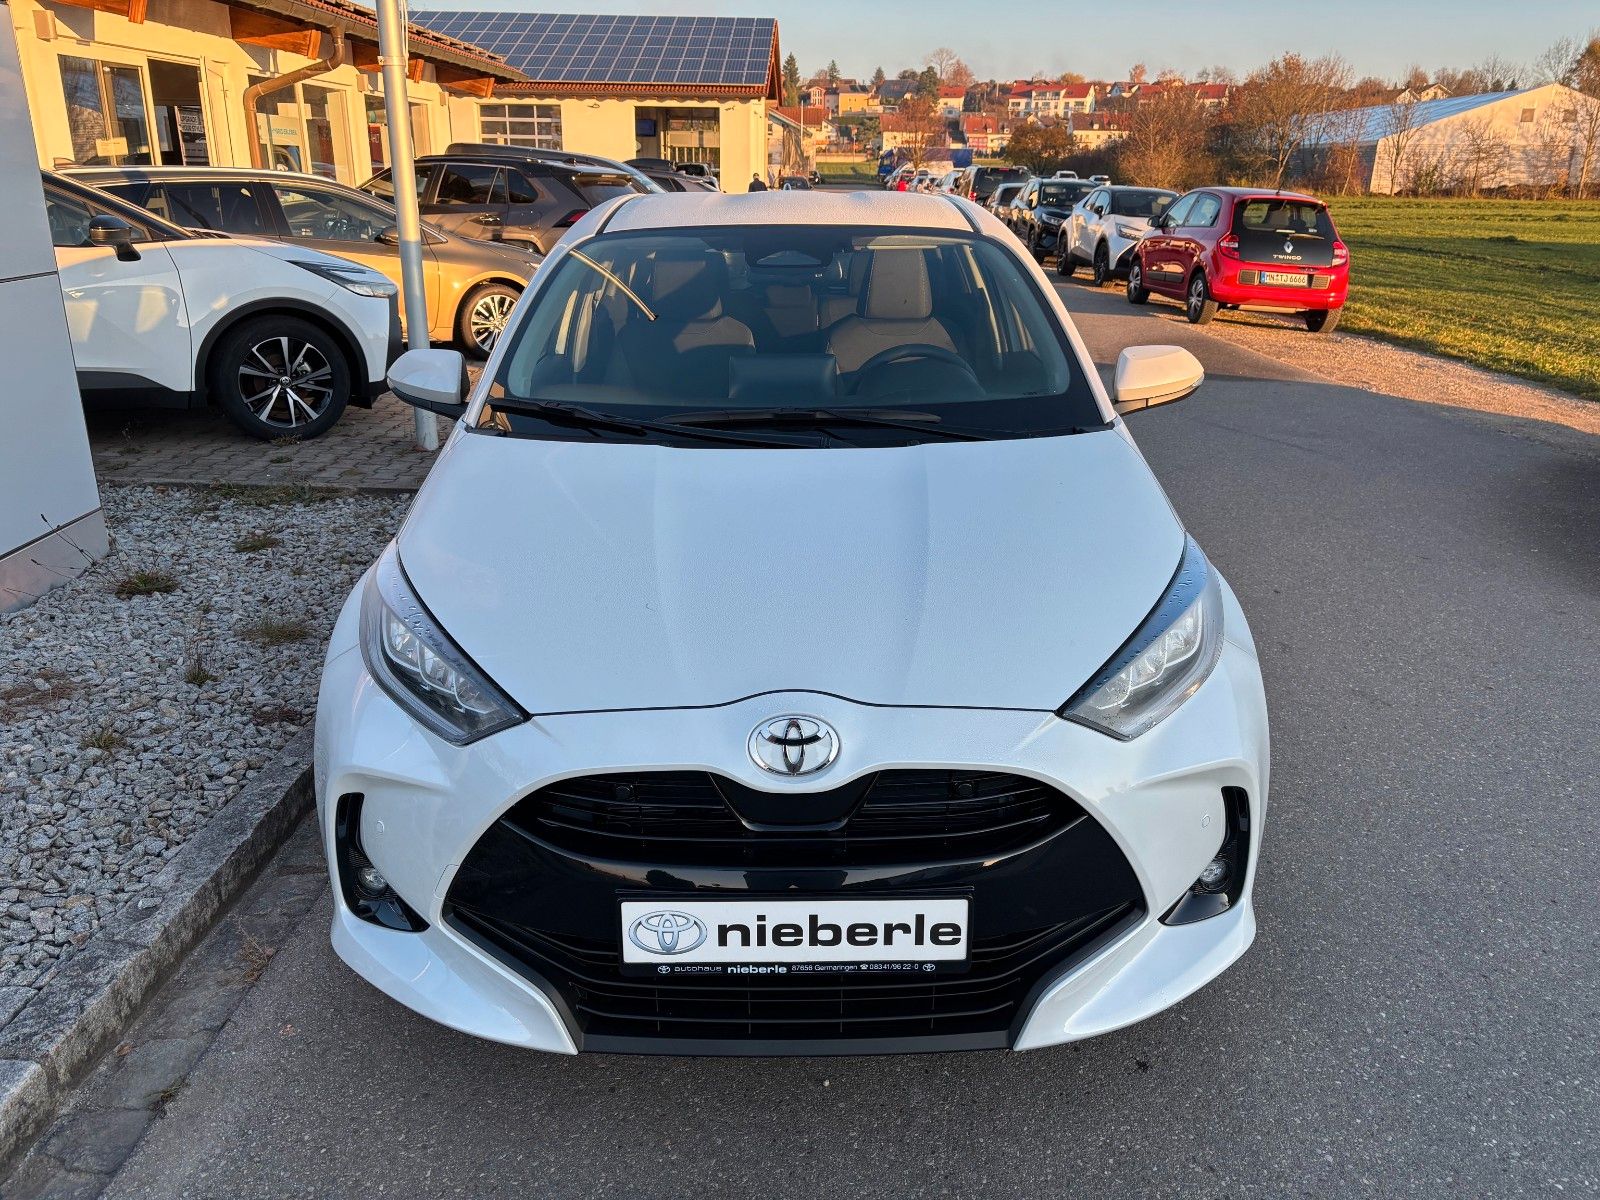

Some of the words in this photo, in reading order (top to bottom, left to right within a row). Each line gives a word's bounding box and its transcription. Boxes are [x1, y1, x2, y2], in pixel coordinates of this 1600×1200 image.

[1266, 273, 1275, 281] MN
[1280, 274, 1289, 282] TJ
[717, 914, 962, 947] nieberle
[727, 964, 788, 974] nieberle
